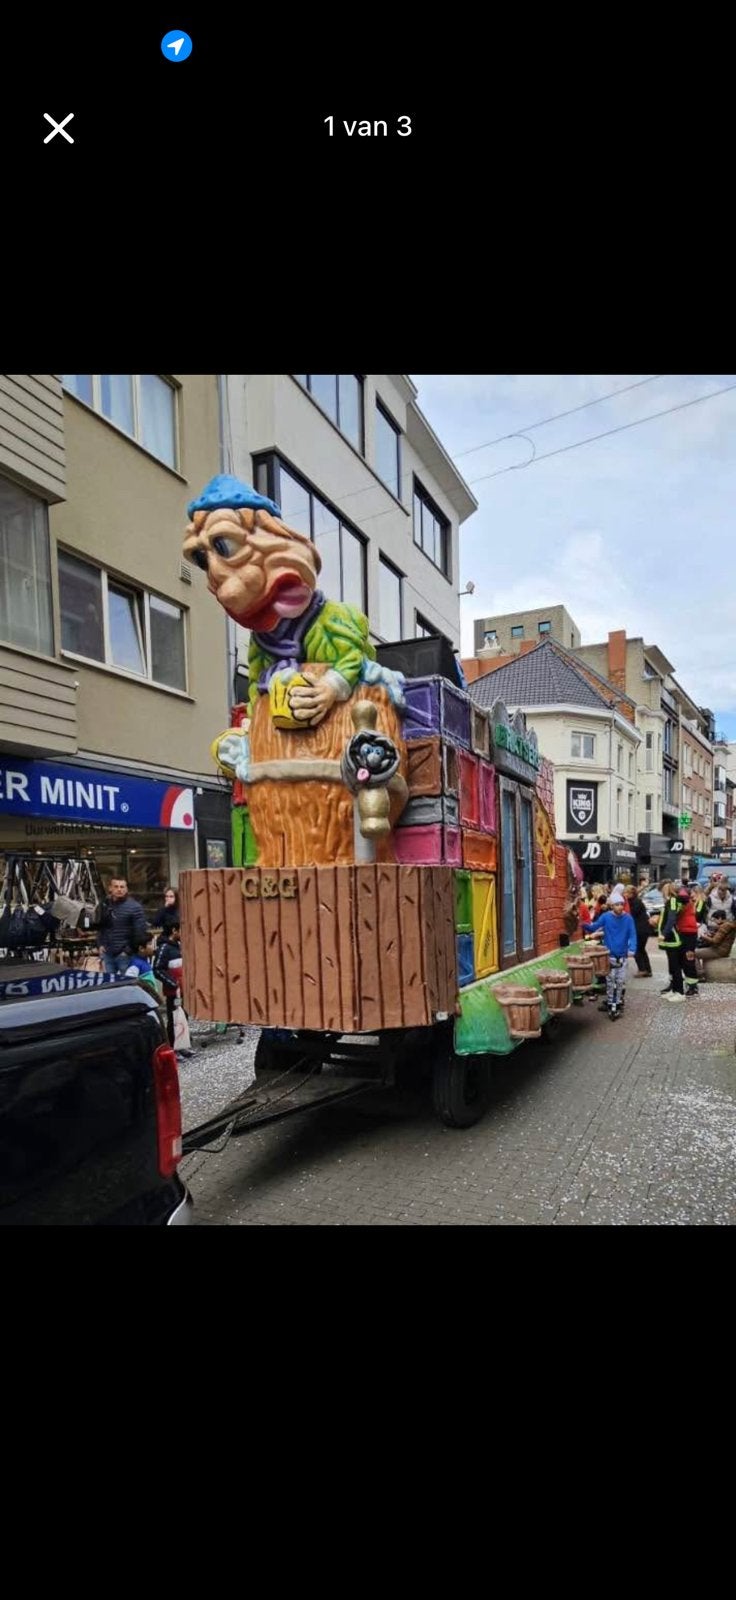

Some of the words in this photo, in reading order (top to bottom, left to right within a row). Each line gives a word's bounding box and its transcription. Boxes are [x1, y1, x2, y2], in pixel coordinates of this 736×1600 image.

[0, 770, 31, 802] R
[582, 842, 601, 859] JD
[670, 842, 683, 851] JD
